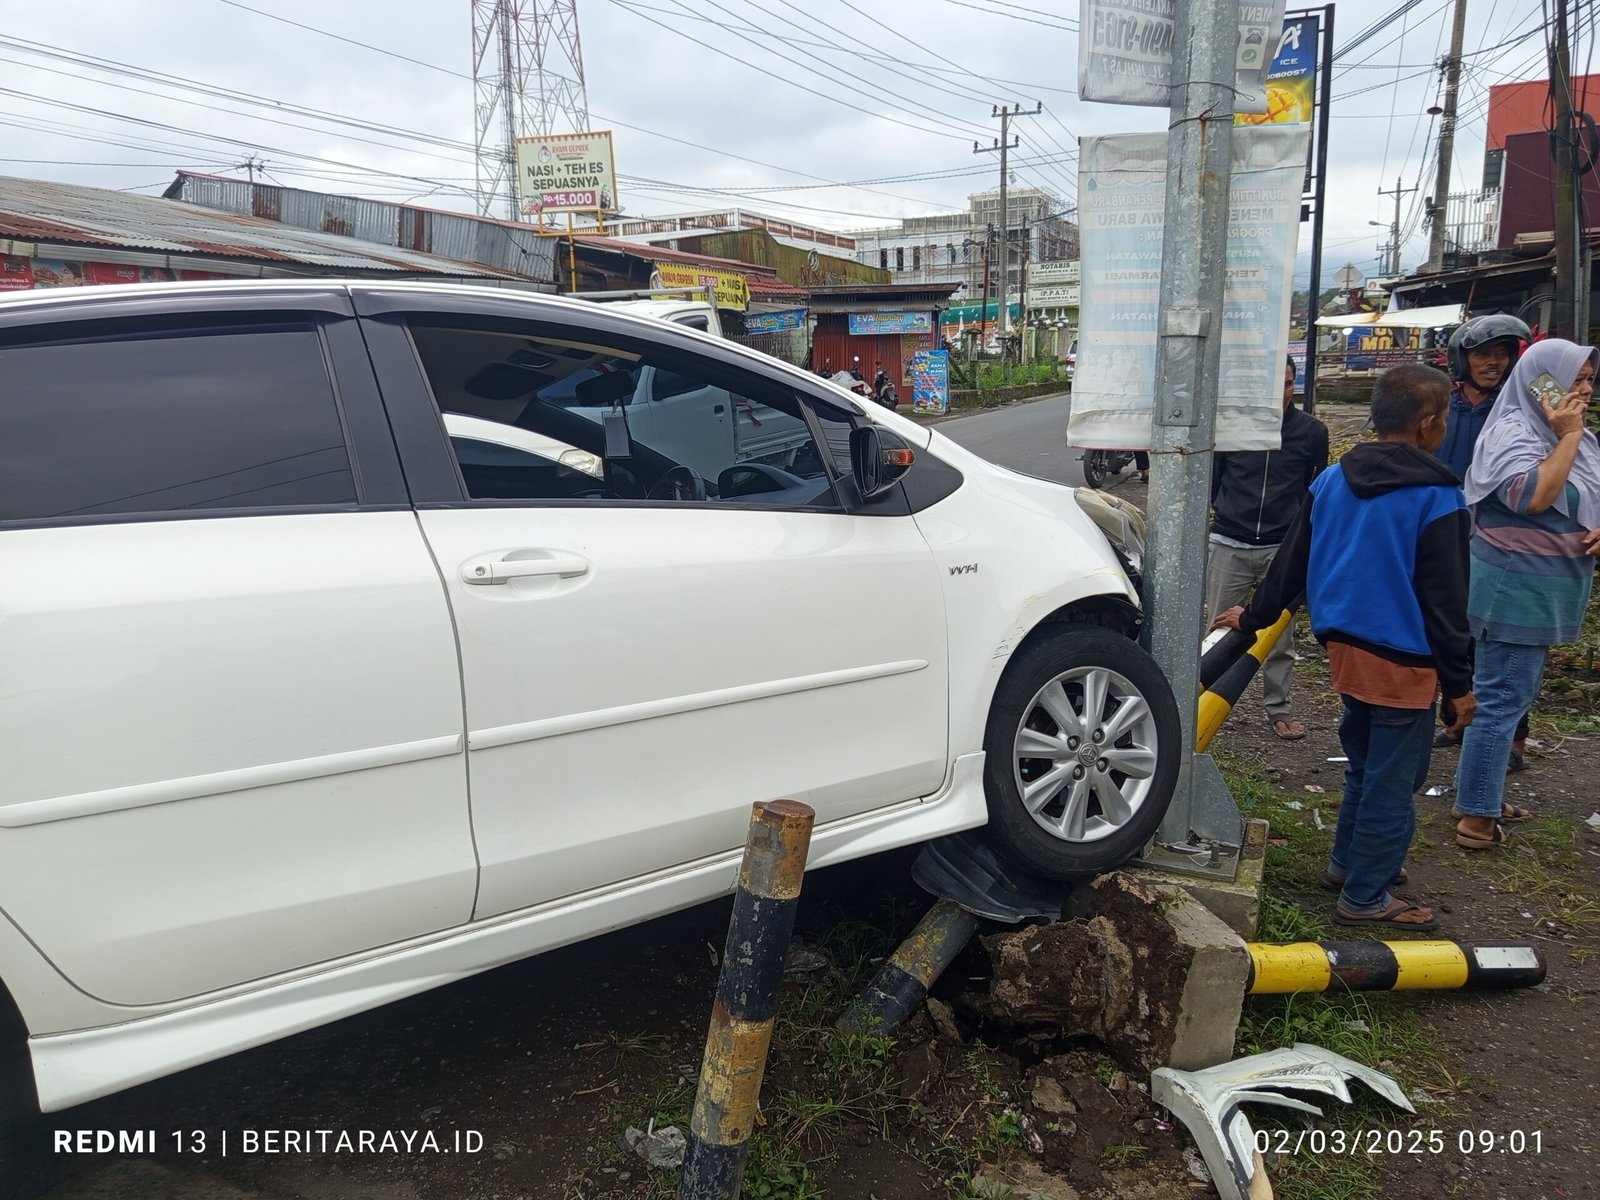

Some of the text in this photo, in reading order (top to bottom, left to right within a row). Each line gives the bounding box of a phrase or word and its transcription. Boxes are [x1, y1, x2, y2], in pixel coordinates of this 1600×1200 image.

[527, 165, 554, 177] NASI
[564, 162, 587, 175] TEH
[589, 162, 604, 173] ES
[533, 176, 600, 190] SEPUASNYA
[1040, 262, 1071, 270] NOTARIS
[857, 314, 873, 322] EVA
